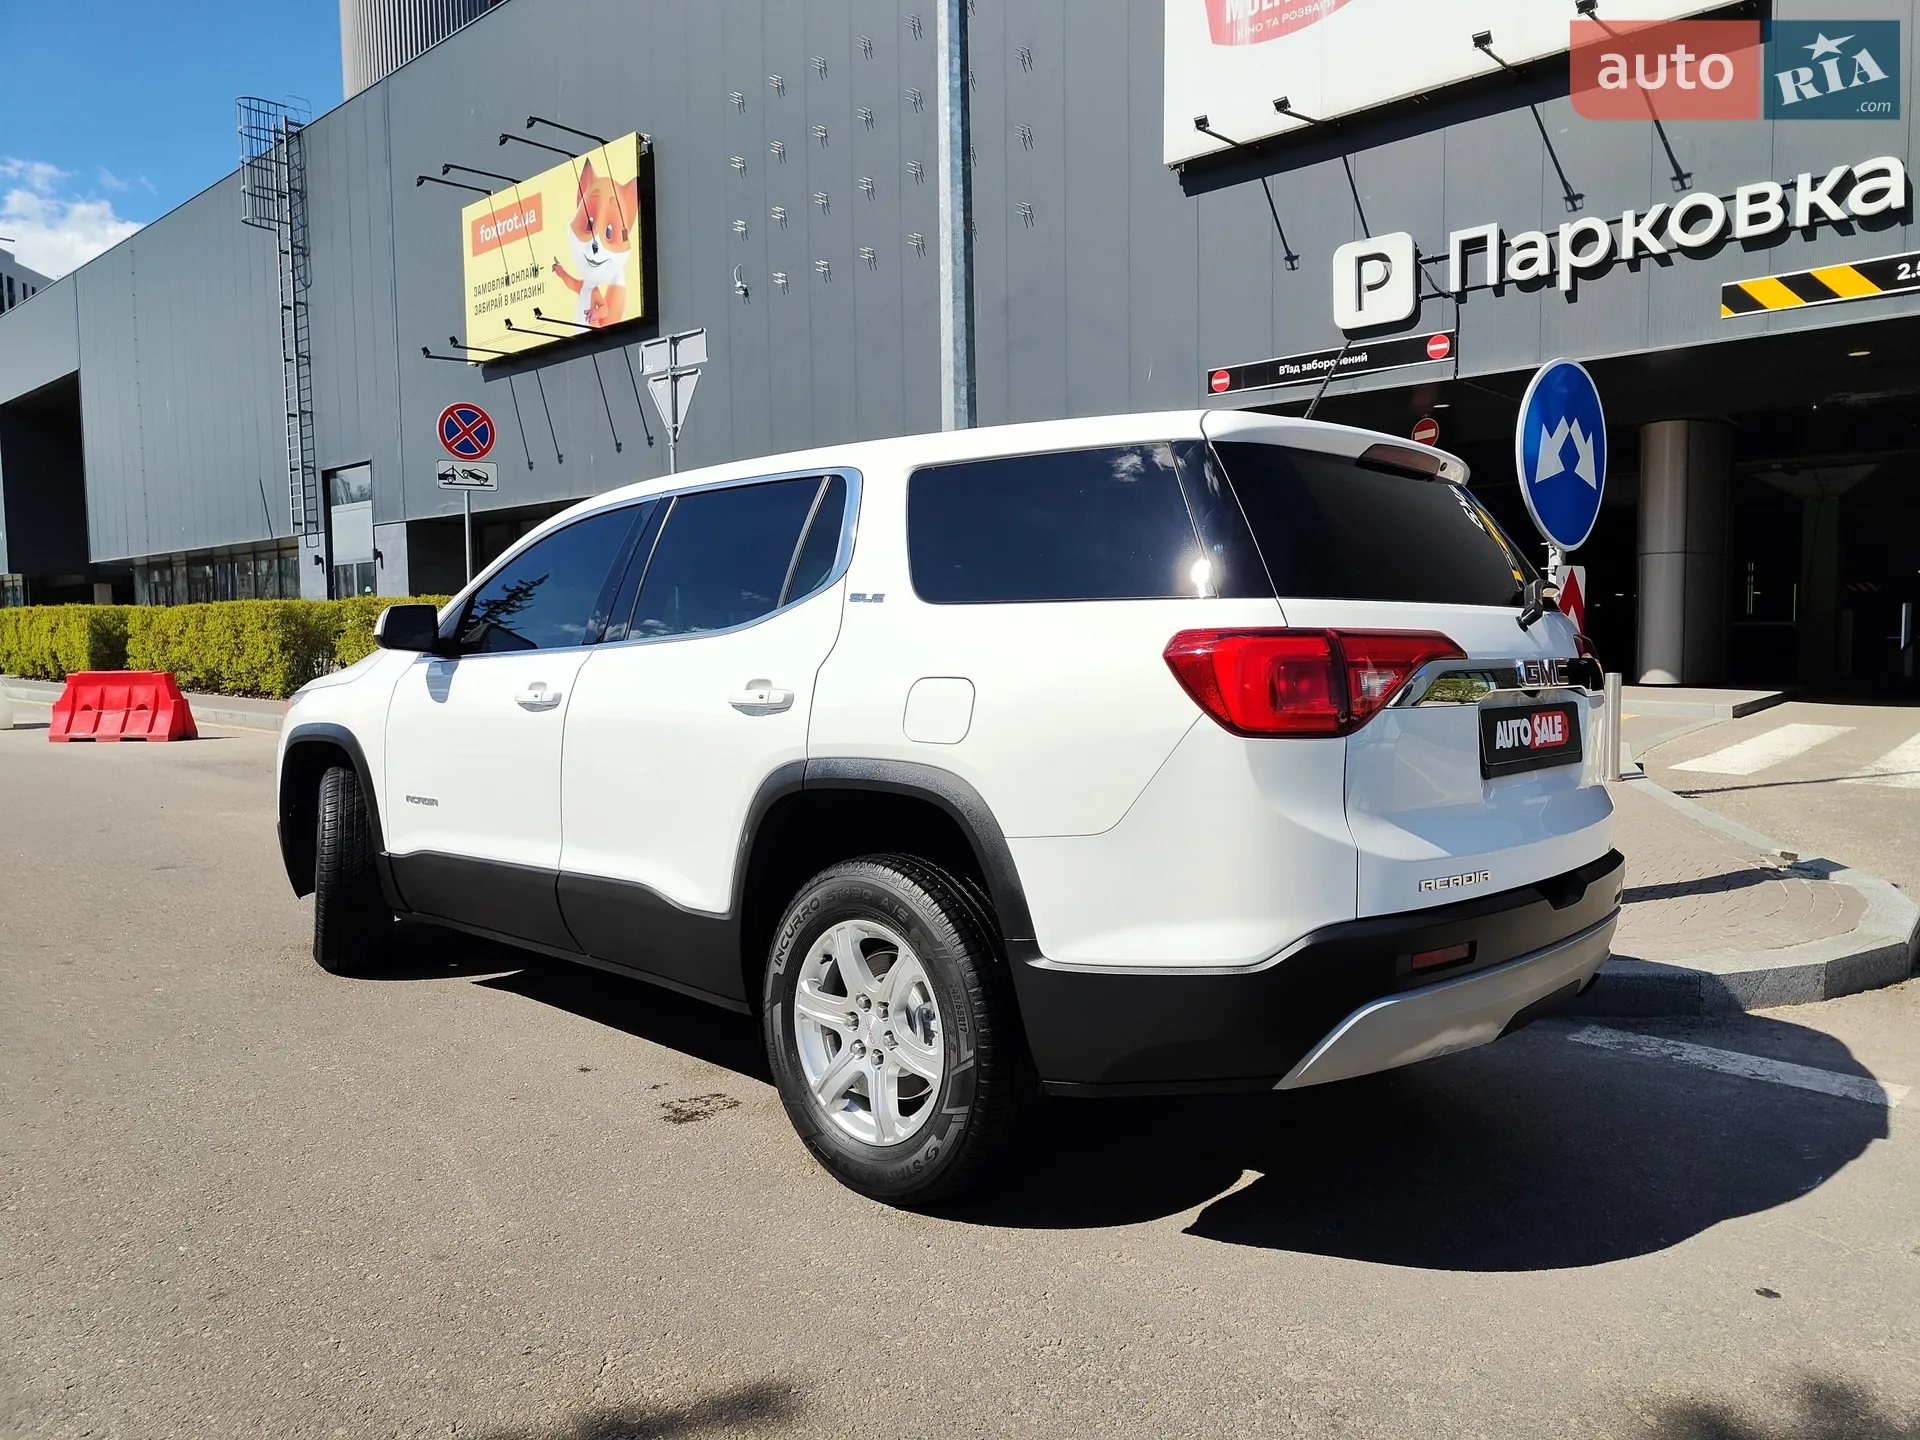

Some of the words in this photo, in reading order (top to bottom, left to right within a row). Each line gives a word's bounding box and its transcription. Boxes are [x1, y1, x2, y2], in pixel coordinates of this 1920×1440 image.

[1265, 17, 1280, 30] ТА
[479, 208, 537, 244] foxtrot.ua
[1449, 156, 1907, 292] Парковка
[473, 271, 510, 298] ЗАМОВЛЯЙ
[1354, 252, 1394, 314] P
[474, 293, 503, 316] ЗАБИРАЙ
[504, 294, 509, 306] В
[1517, 658, 1570, 686] GMC
[1495, 717, 1532, 749] AUTO
[1418, 869, 1490, 892] ACADIA
[774, 896, 821, 967] INCURRO
